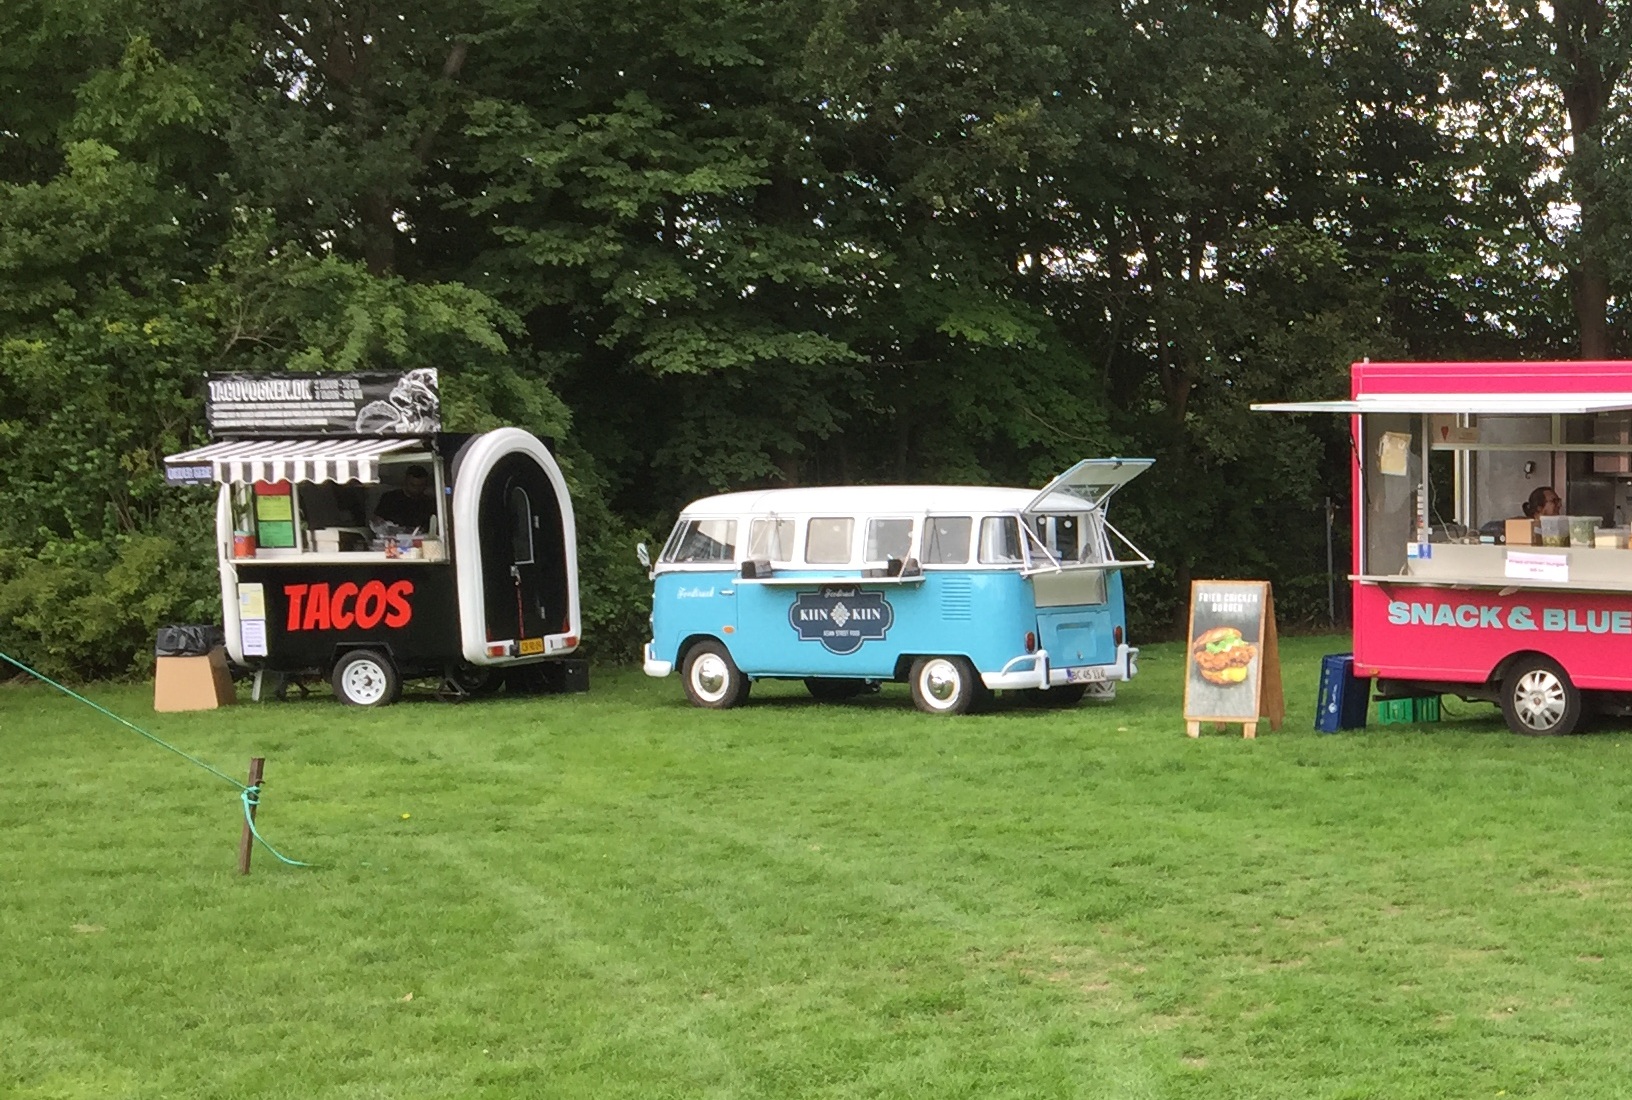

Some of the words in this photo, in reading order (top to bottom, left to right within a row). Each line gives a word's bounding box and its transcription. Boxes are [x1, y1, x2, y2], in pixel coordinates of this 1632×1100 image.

[284, 580, 414, 631] TACOS
[800, 608, 828, 621] KIIN
[852, 608, 881, 620] KIIN
[1388, 601, 1504, 630] SNACK
[1507, 606, 1539, 631] &
